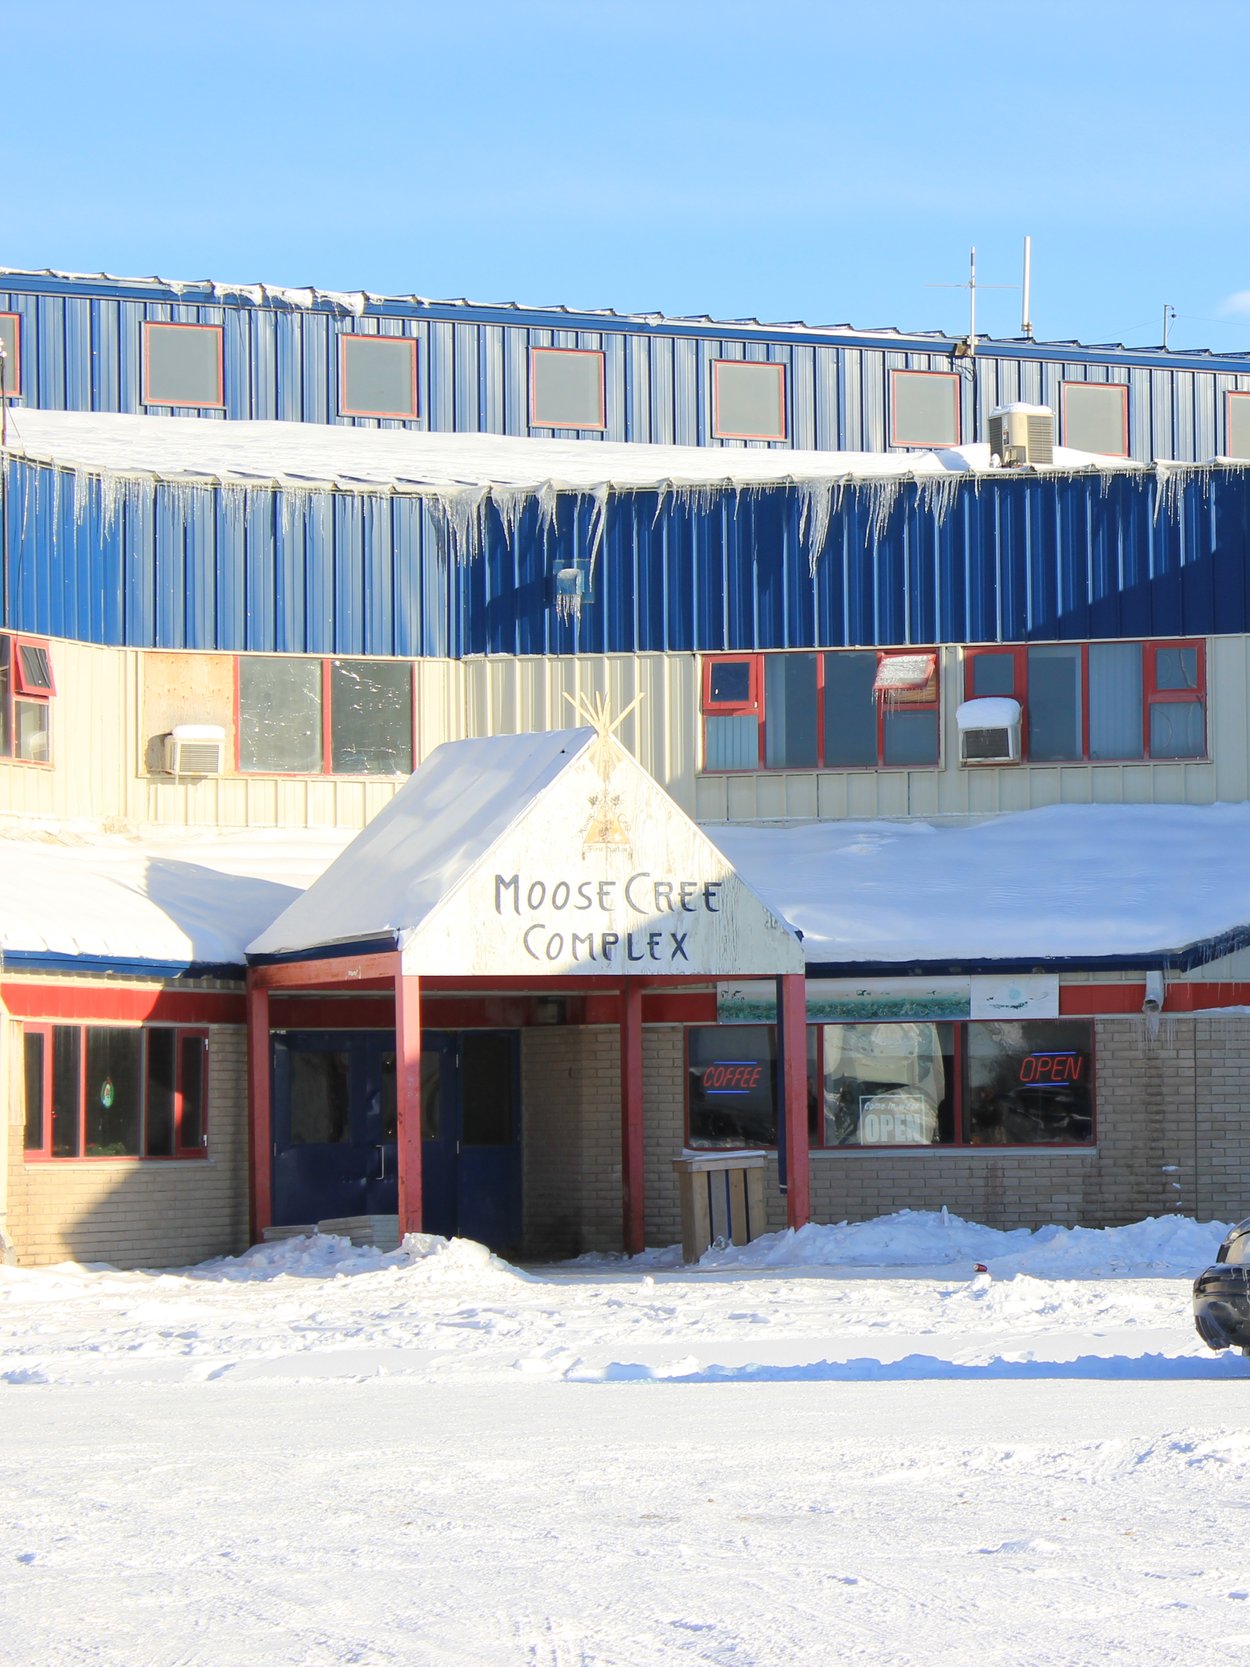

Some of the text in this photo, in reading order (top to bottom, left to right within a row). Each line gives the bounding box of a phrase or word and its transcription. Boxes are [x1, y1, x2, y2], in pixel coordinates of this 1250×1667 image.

[494, 872, 723, 916] MOOSE CREE
[523, 923, 689, 961] COMPLEX
[703, 1066, 762, 1088] COFFEE
[1020, 1057, 1082, 1081] OPEN
[865, 1114, 921, 1142] OPEN
